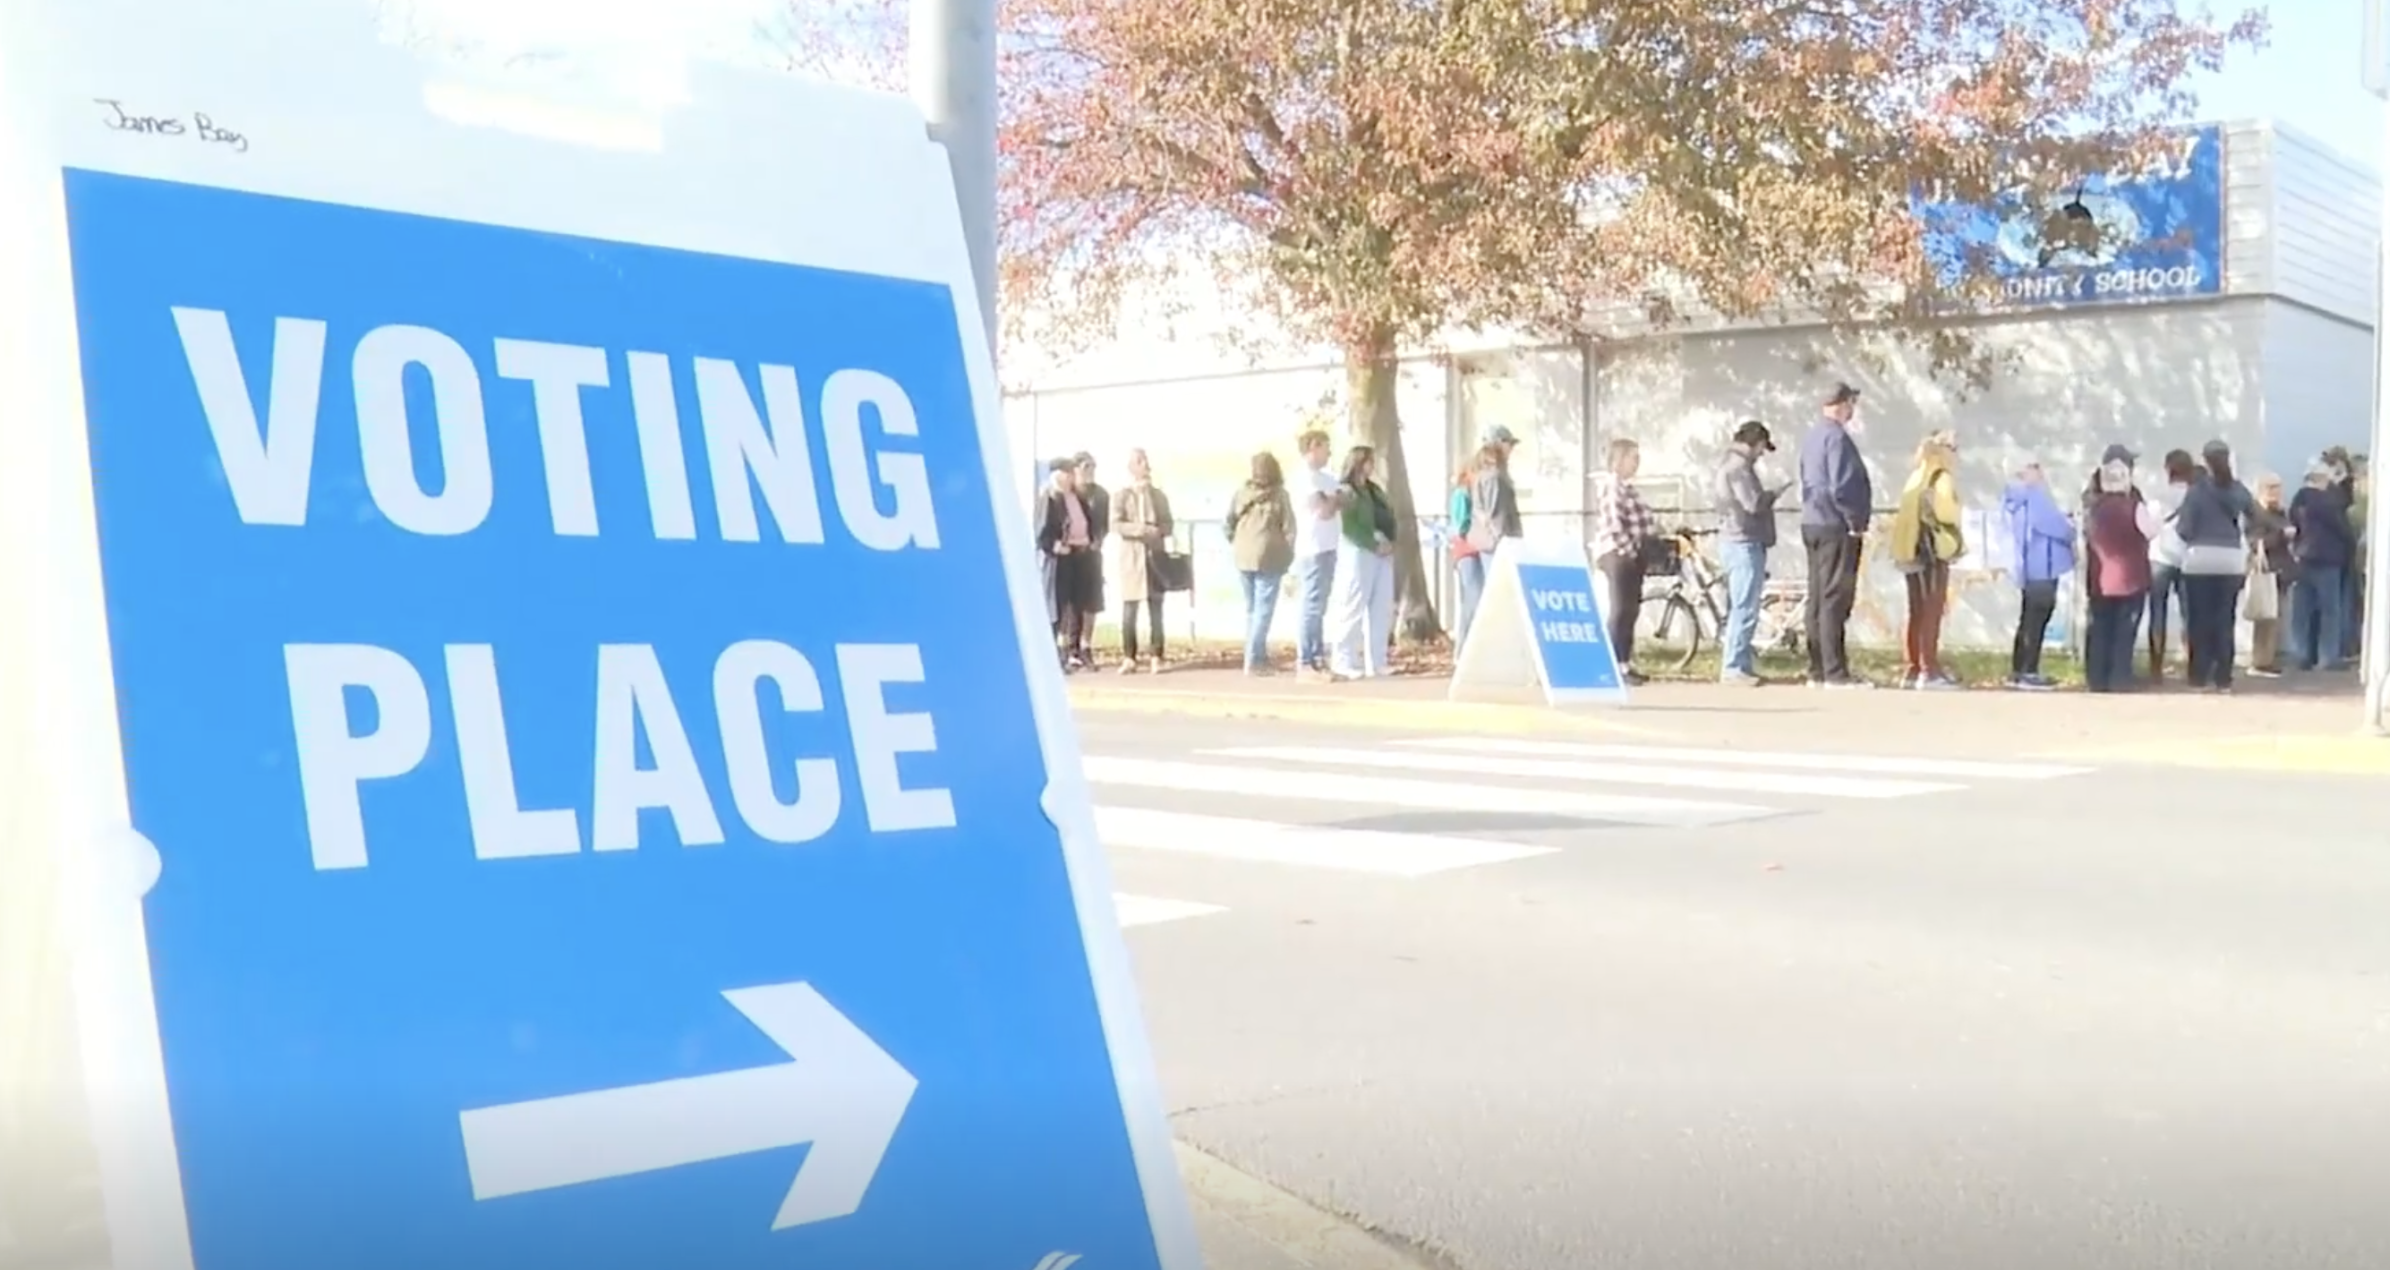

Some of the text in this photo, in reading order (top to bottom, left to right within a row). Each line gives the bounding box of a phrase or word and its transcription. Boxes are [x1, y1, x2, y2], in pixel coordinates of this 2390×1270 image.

[93, 98, 248, 153] James Bay
[2095, 265, 2200, 293] SCHOOL
[172, 307, 940, 551] VOTING
[1531, 589, 1591, 612] VOTE
[1541, 621, 1599, 643] HERE
[285, 640, 957, 870] PLACE
